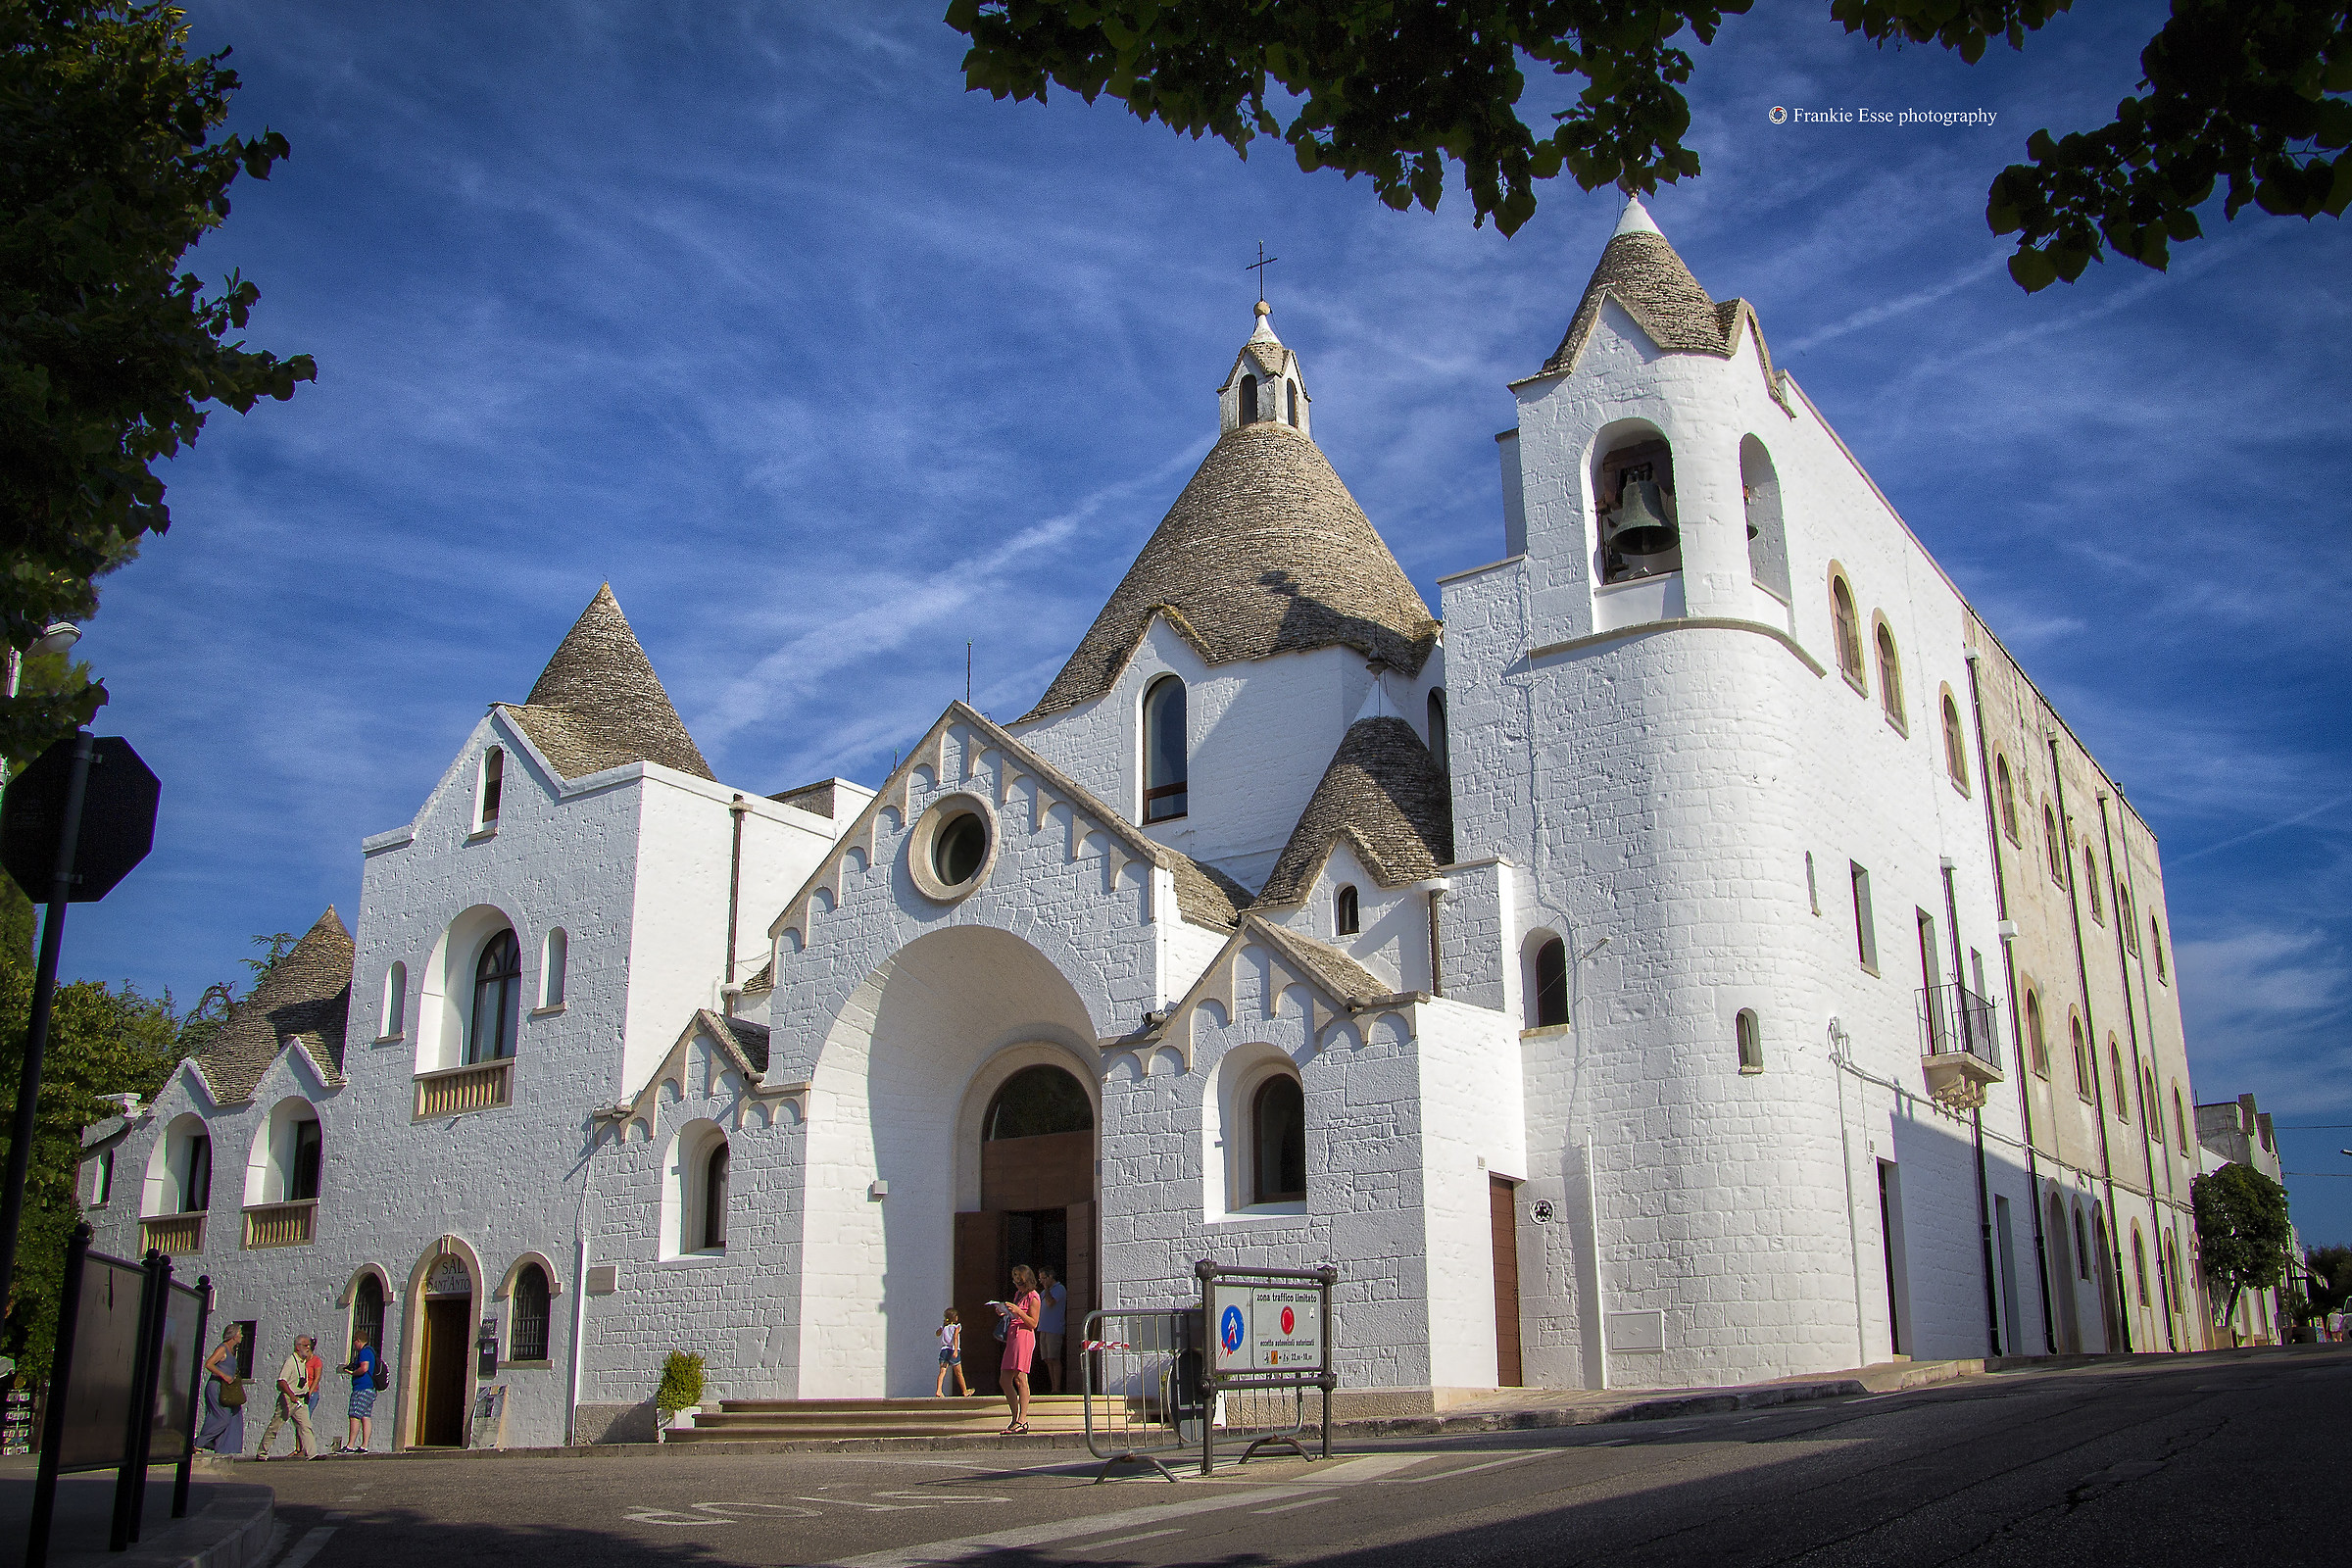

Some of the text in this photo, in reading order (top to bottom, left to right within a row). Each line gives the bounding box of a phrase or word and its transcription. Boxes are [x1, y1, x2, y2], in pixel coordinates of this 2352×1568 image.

[442, 1258, 466, 1274] SAL
[1272, 1292, 1294, 1302] traffico
[621, 1491, 1013, 1526] STOP
